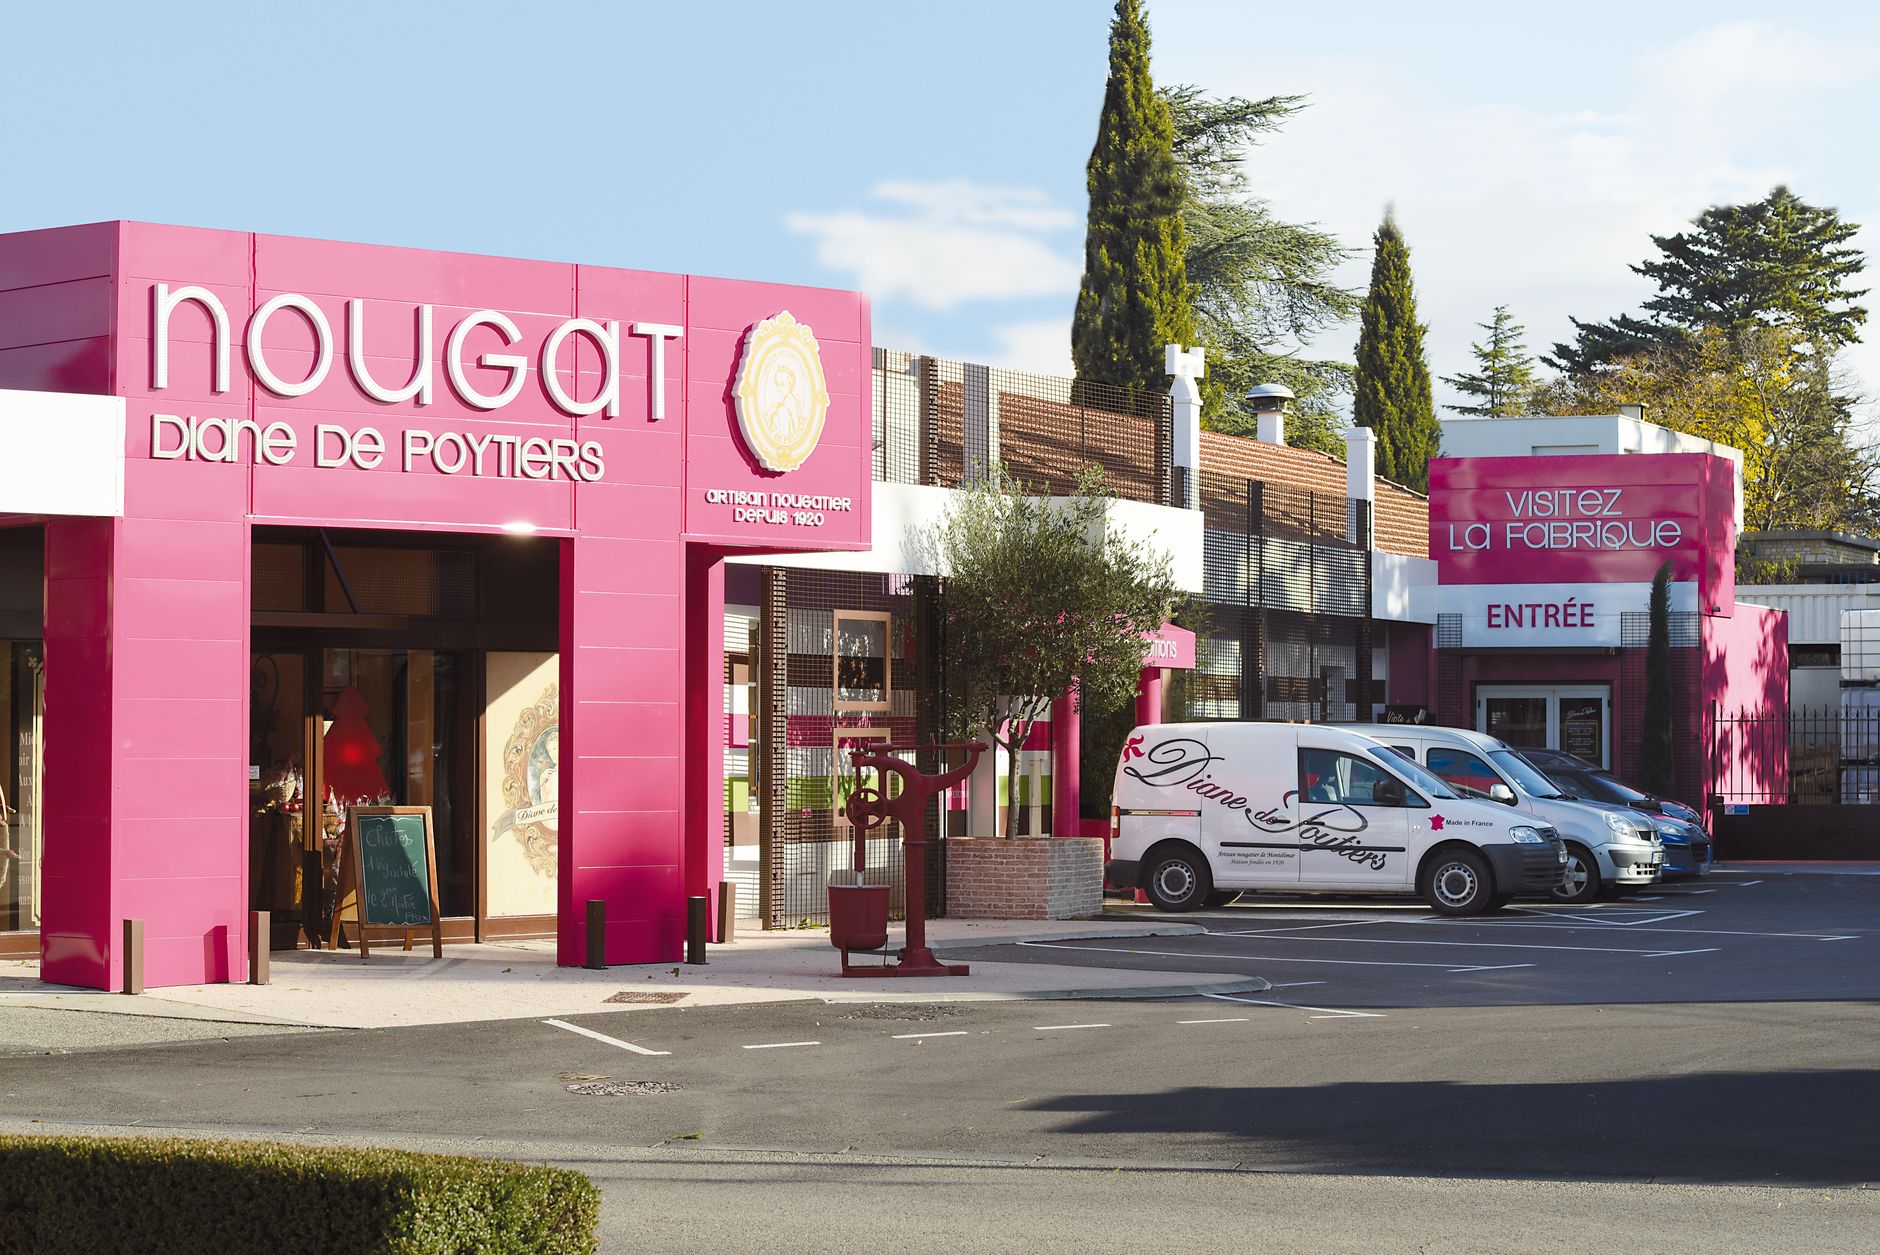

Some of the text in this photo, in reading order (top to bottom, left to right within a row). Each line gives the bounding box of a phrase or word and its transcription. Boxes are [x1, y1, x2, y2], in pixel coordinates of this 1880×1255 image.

[792, 511, 825, 526] 1920
[1487, 596, 1595, 628] ENTRÉE
[1124, 738, 1248, 809] Diane
[518, 804, 557, 821] Diane de
[1217, 851, 1236, 859] Artisan
